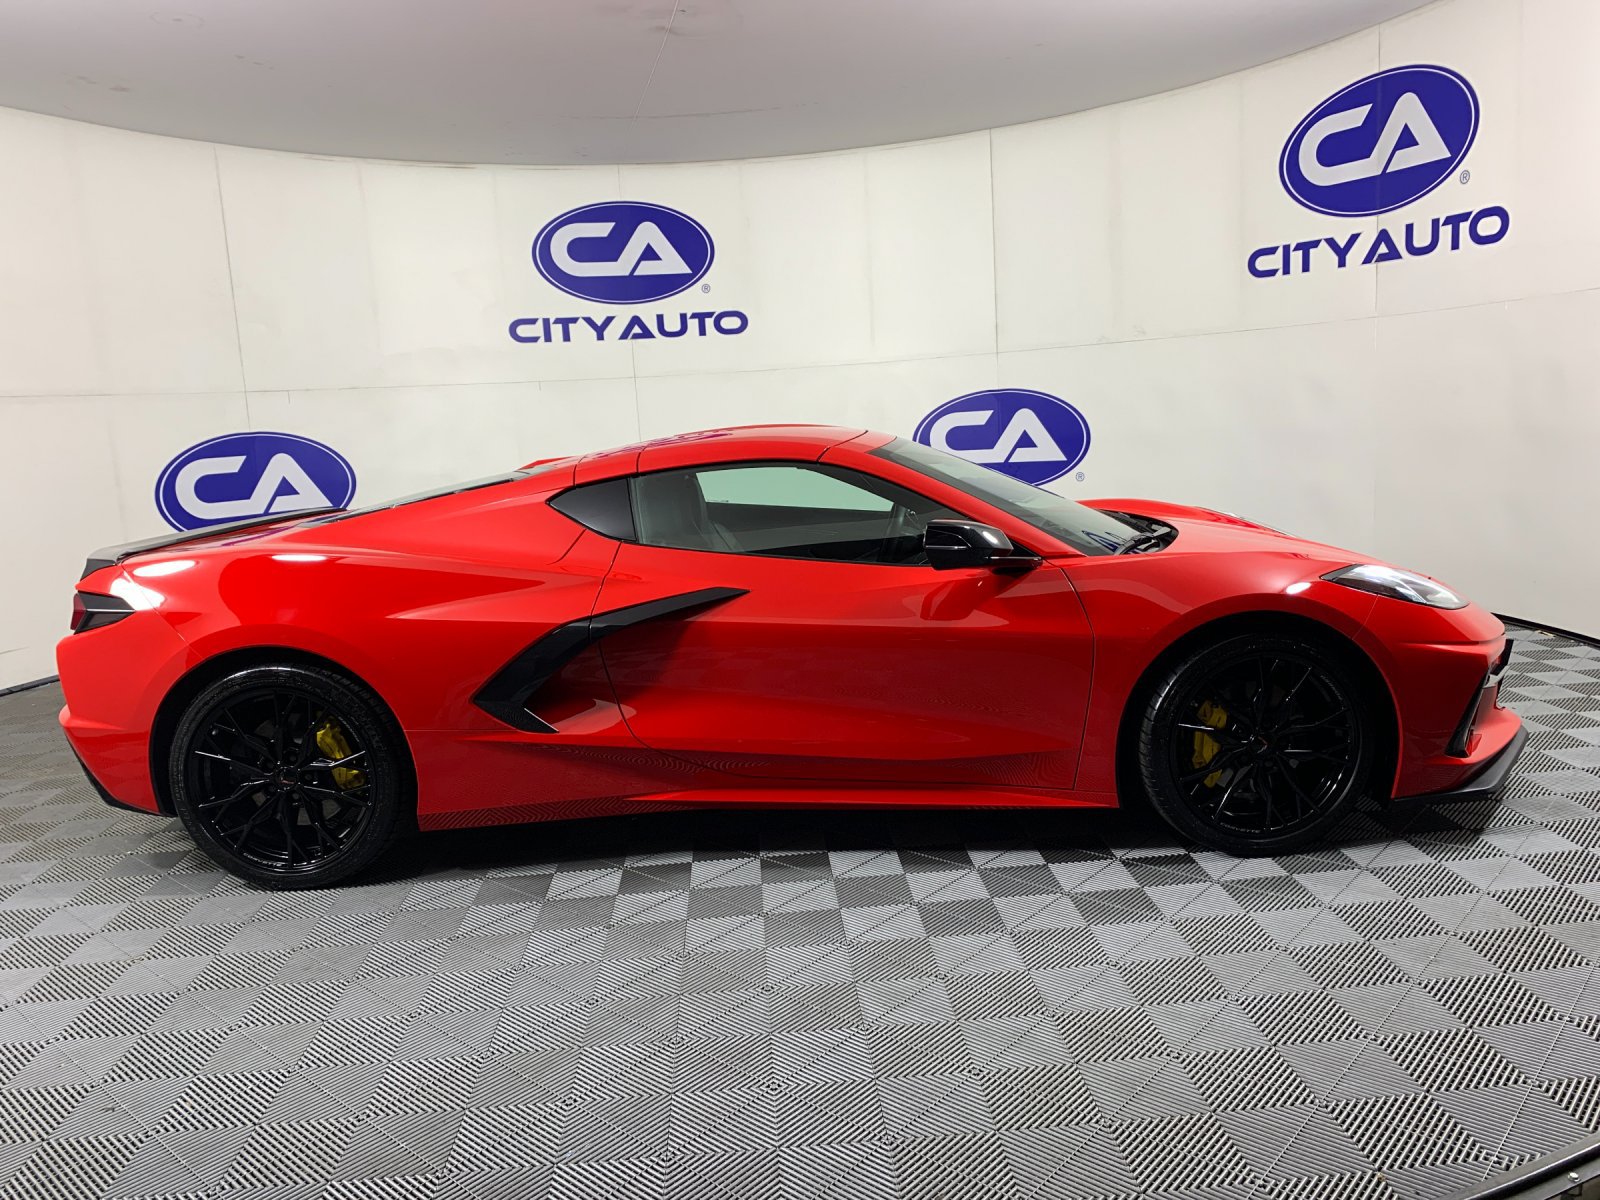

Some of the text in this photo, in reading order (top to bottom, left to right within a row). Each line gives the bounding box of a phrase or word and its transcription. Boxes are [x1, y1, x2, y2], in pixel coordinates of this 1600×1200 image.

[1299, 91, 1452, 187] CA
[550, 221, 693, 277] CA
[1247, 205, 1510, 279] CITY AUTO
[508, 310, 749, 343] CITY AUTO
[929, 407, 1068, 464] CA
[175, 452, 334, 519] CA
